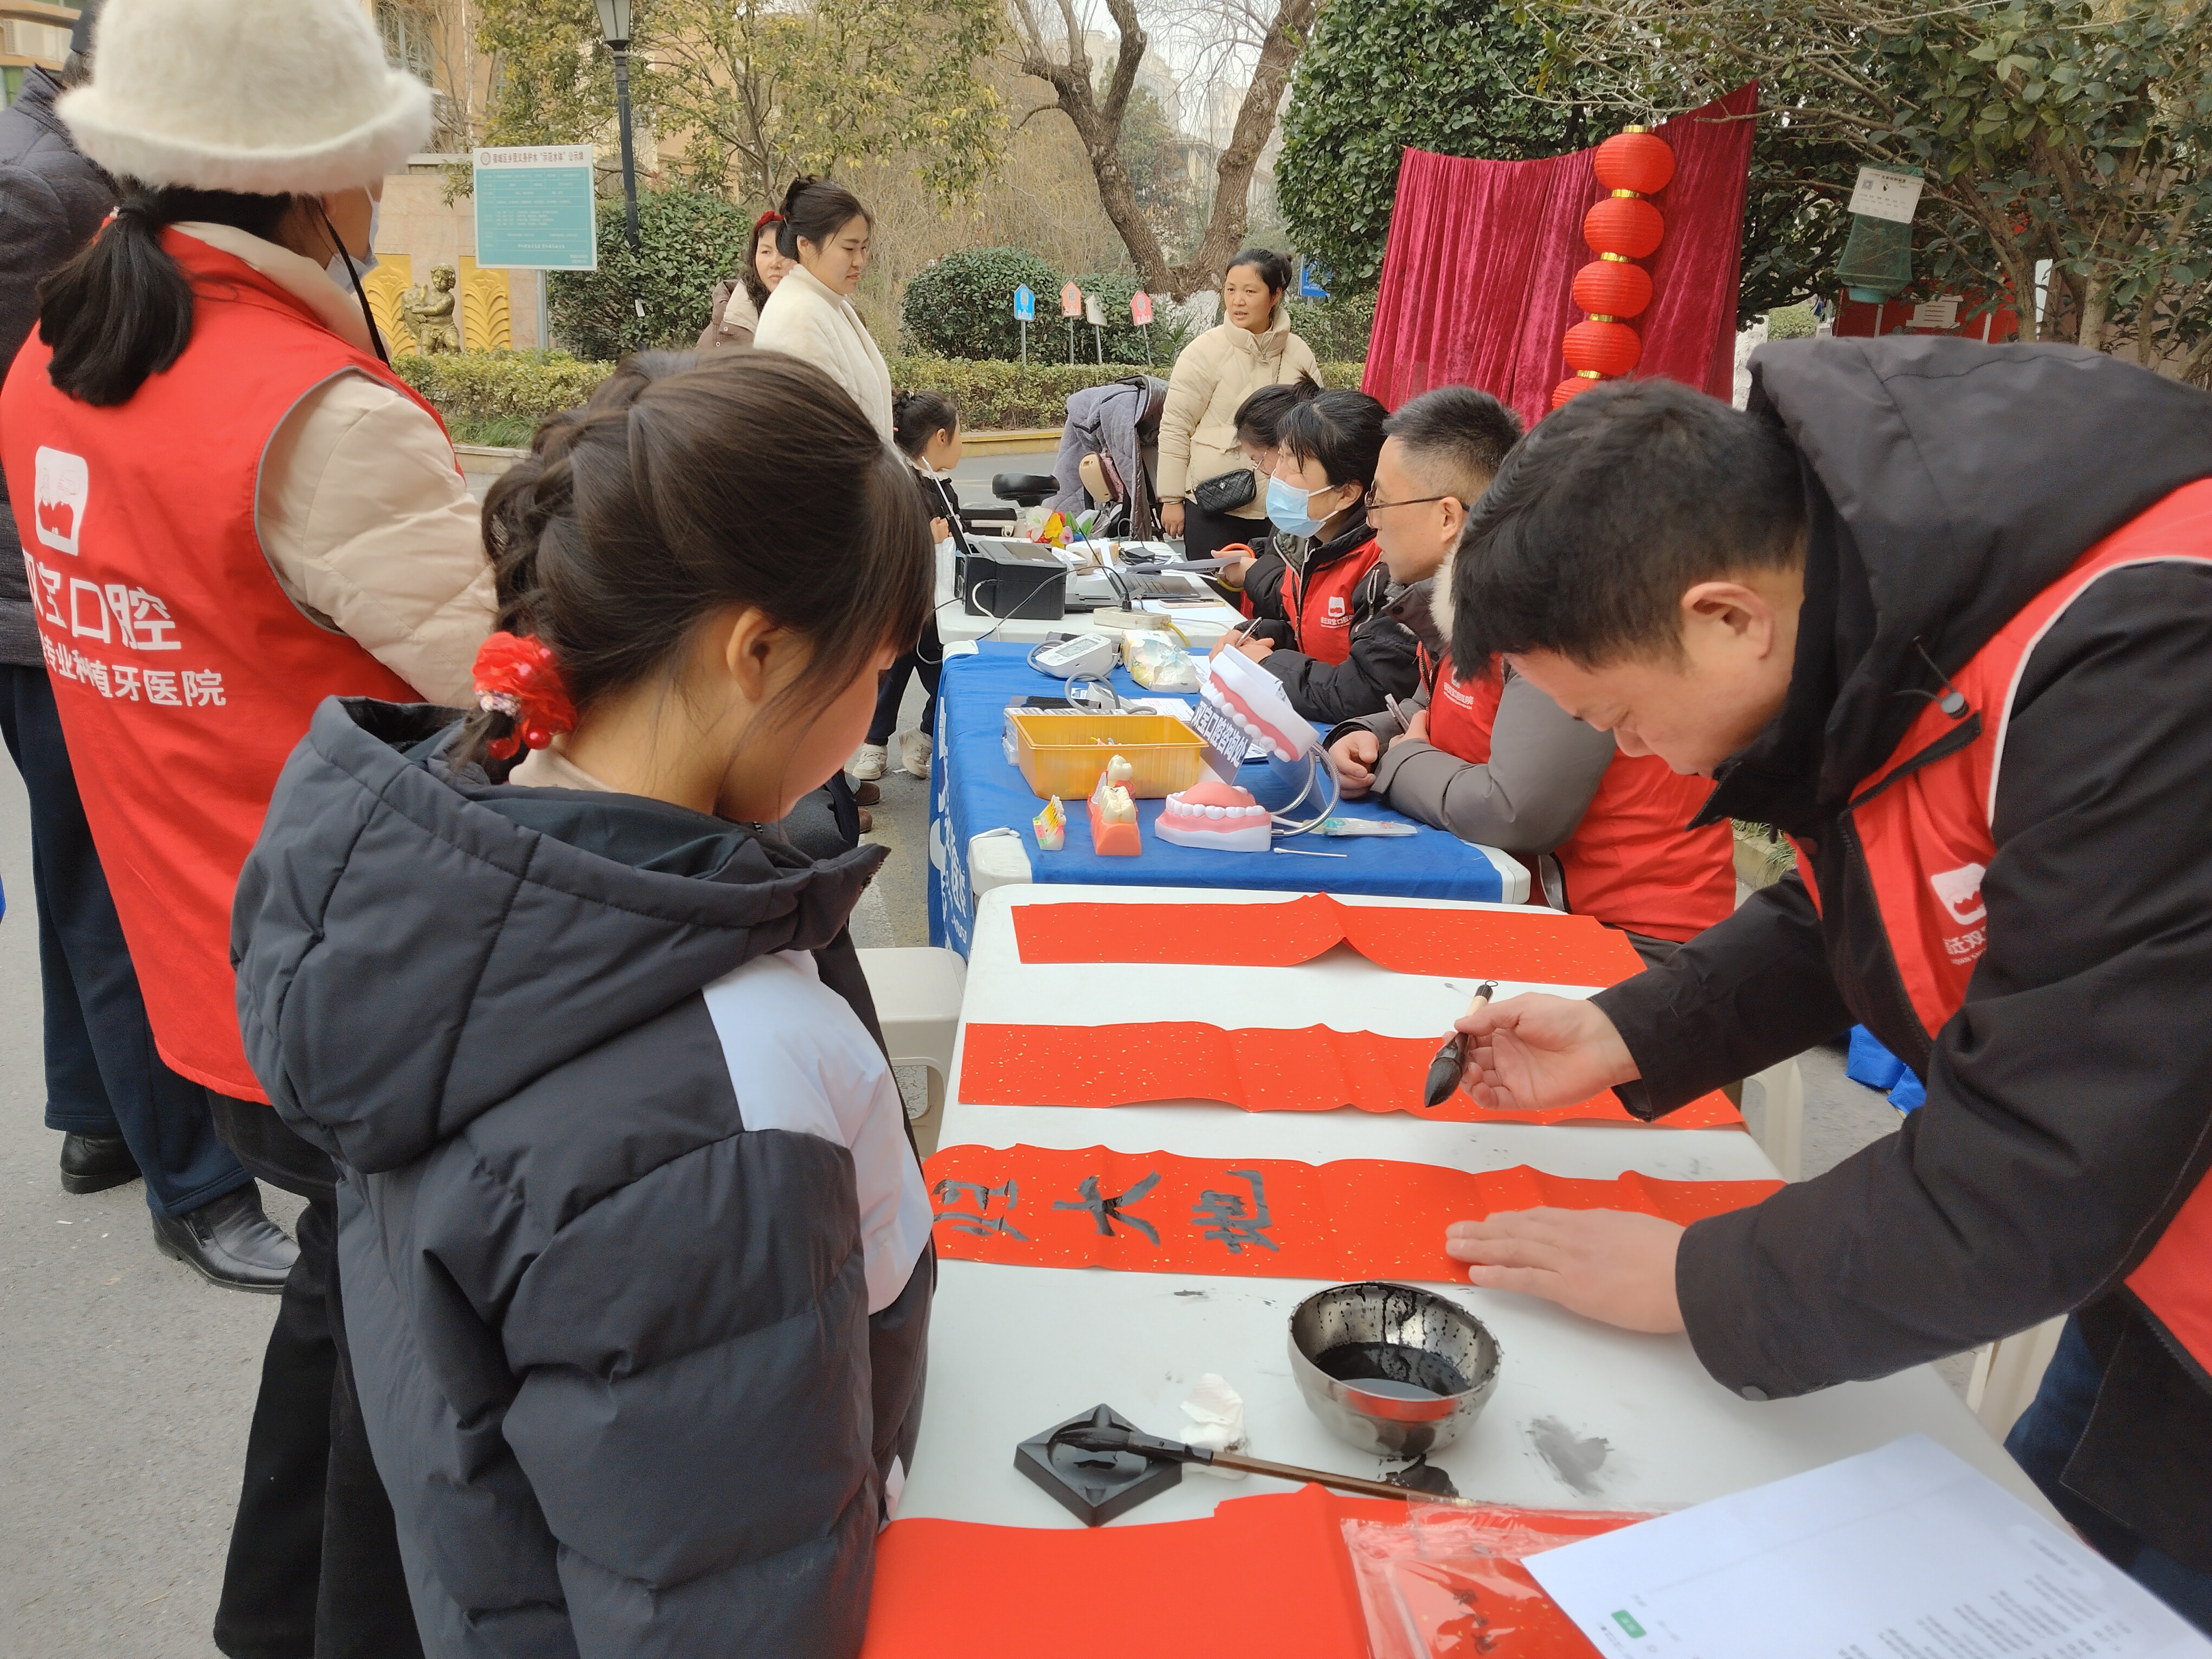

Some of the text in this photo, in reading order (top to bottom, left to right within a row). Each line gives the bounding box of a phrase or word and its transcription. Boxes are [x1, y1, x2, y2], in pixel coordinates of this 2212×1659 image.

[38, 628, 226, 706] 专业种植牙医院
[1191, 700, 1249, 768] 双宝口腔咨询处
